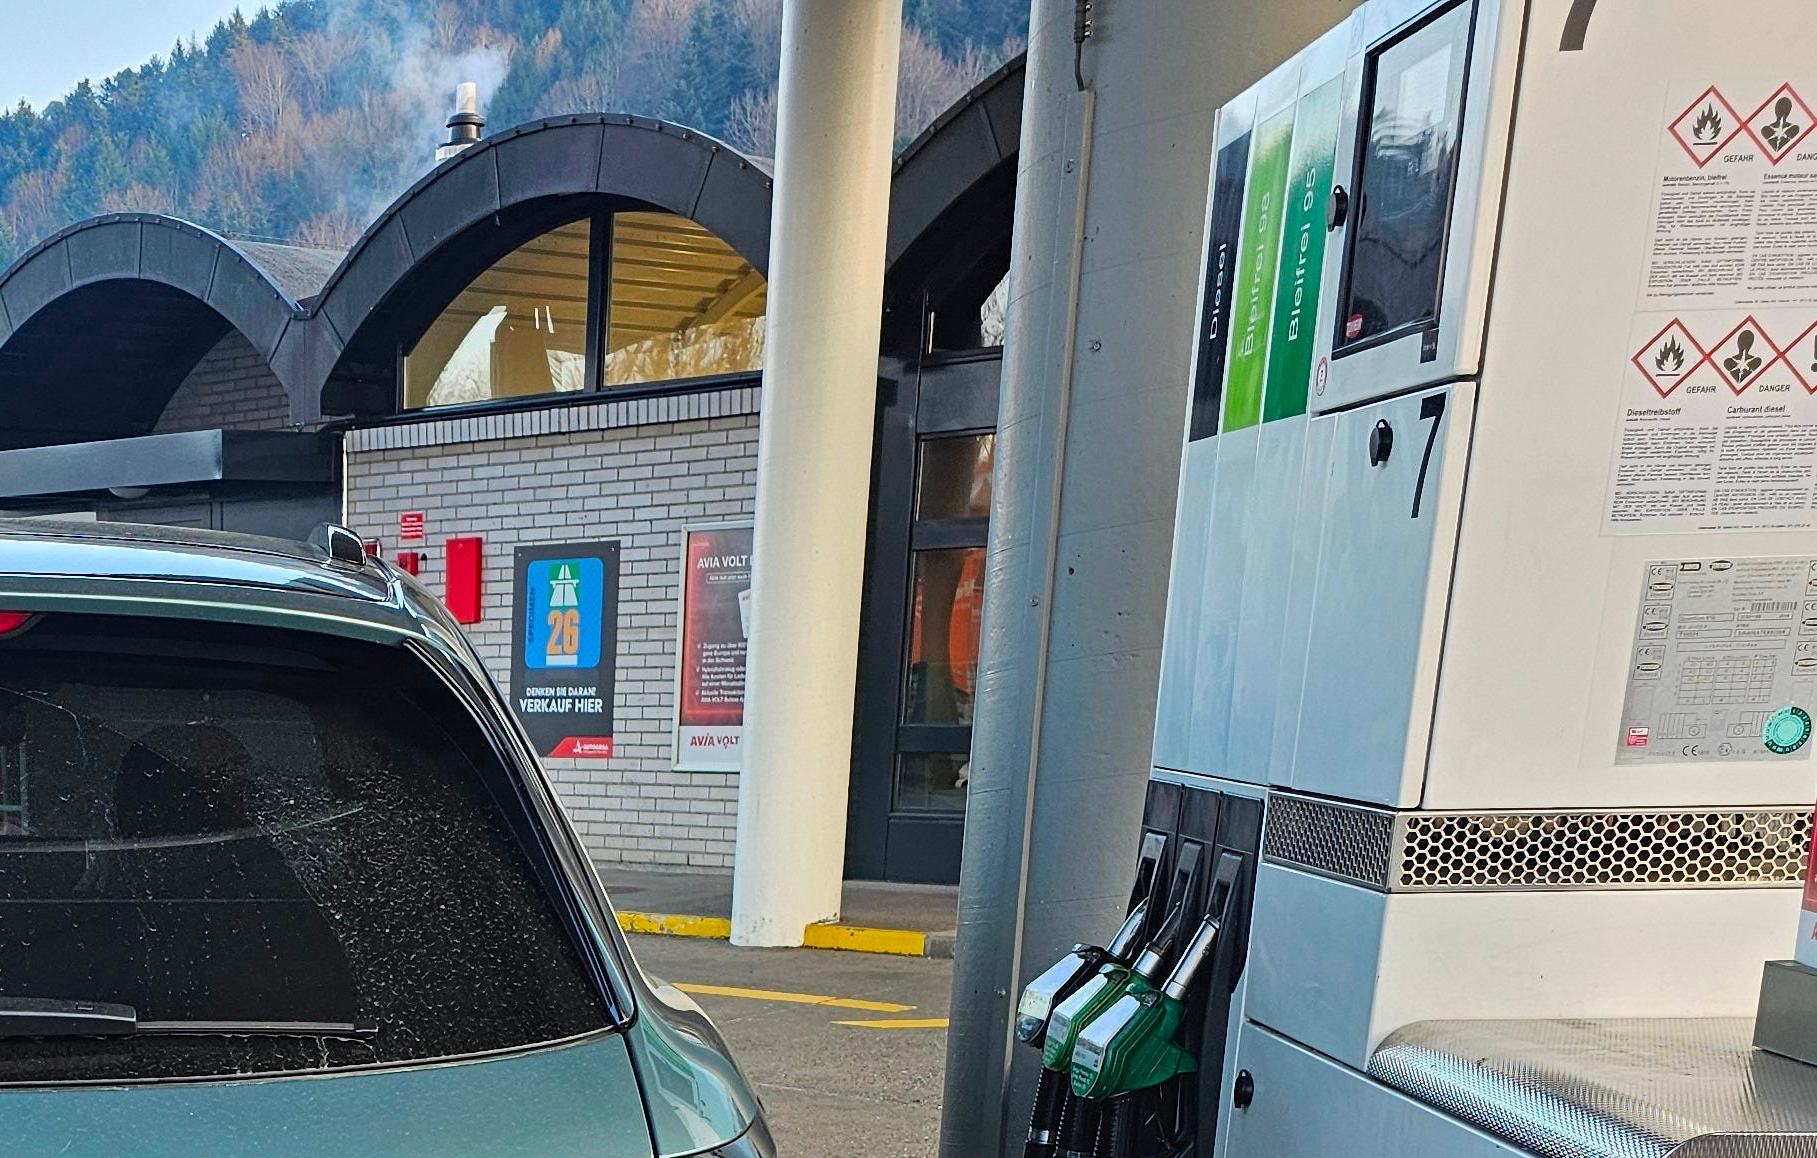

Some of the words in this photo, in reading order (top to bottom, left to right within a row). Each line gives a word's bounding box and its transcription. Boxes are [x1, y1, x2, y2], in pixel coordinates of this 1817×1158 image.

[1723, 154, 1754, 163] GEFAHR
[1288, 222, 1311, 342] Bleifrei
[1303, 167, 1317, 211] 95
[1242, 243, 1265, 356] Bleifrei
[1258, 191, 1270, 233] 98
[1208, 243, 1227, 340] Diesel
[1686, 385, 1717, 394] GEFAHR
[1758, 384, 1791, 393] DANGER
[1626, 407, 1682, 417] Dieseltreibstoff
[1727, 405, 1762, 414] Carburant
[1764, 405, 1786, 413] diesel
[1410, 392, 1447, 519] 7
[696, 556, 721, 569] AVIA
[722, 554, 748, 568] VOLT
[527, 587, 536, 643] SPECIMEN
[546, 608, 580, 655] 26
[526, 687, 555, 697] DENKEN
[556, 686, 567, 697] SIE
[519, 698, 573, 713] VERKAUF
[575, 698, 603, 713] HIER
[716, 735, 741, 748] VOLT
